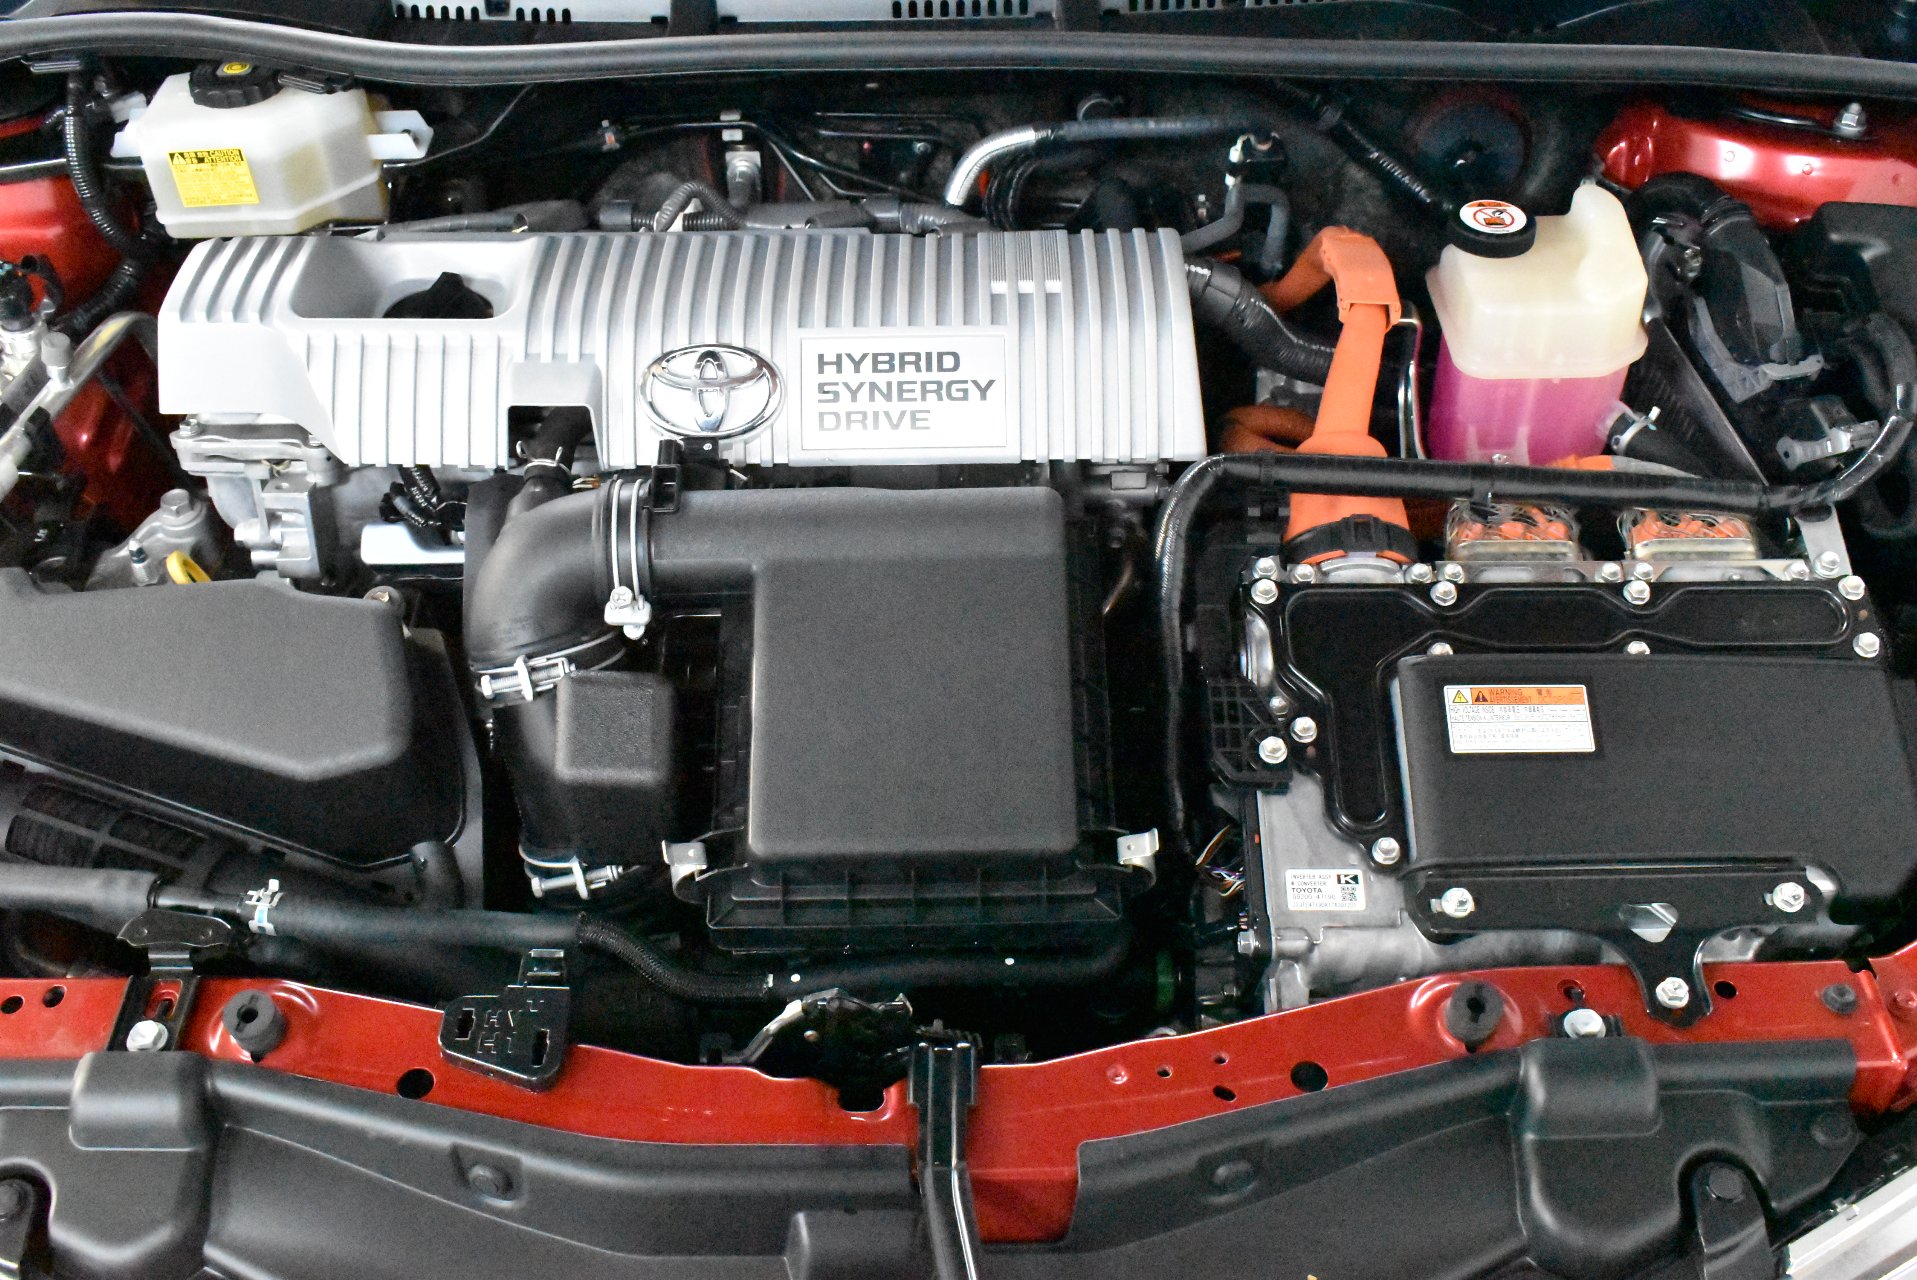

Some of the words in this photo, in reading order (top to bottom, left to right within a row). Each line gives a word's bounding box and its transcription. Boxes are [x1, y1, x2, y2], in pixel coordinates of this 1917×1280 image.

[209, 149, 240, 157] CAUTION
[817, 351, 961, 375] HYBRID
[817, 379, 997, 404] SYNERGY
[818, 409, 931, 432] DRIVE
[1488, 688, 1523, 696] WARNING
